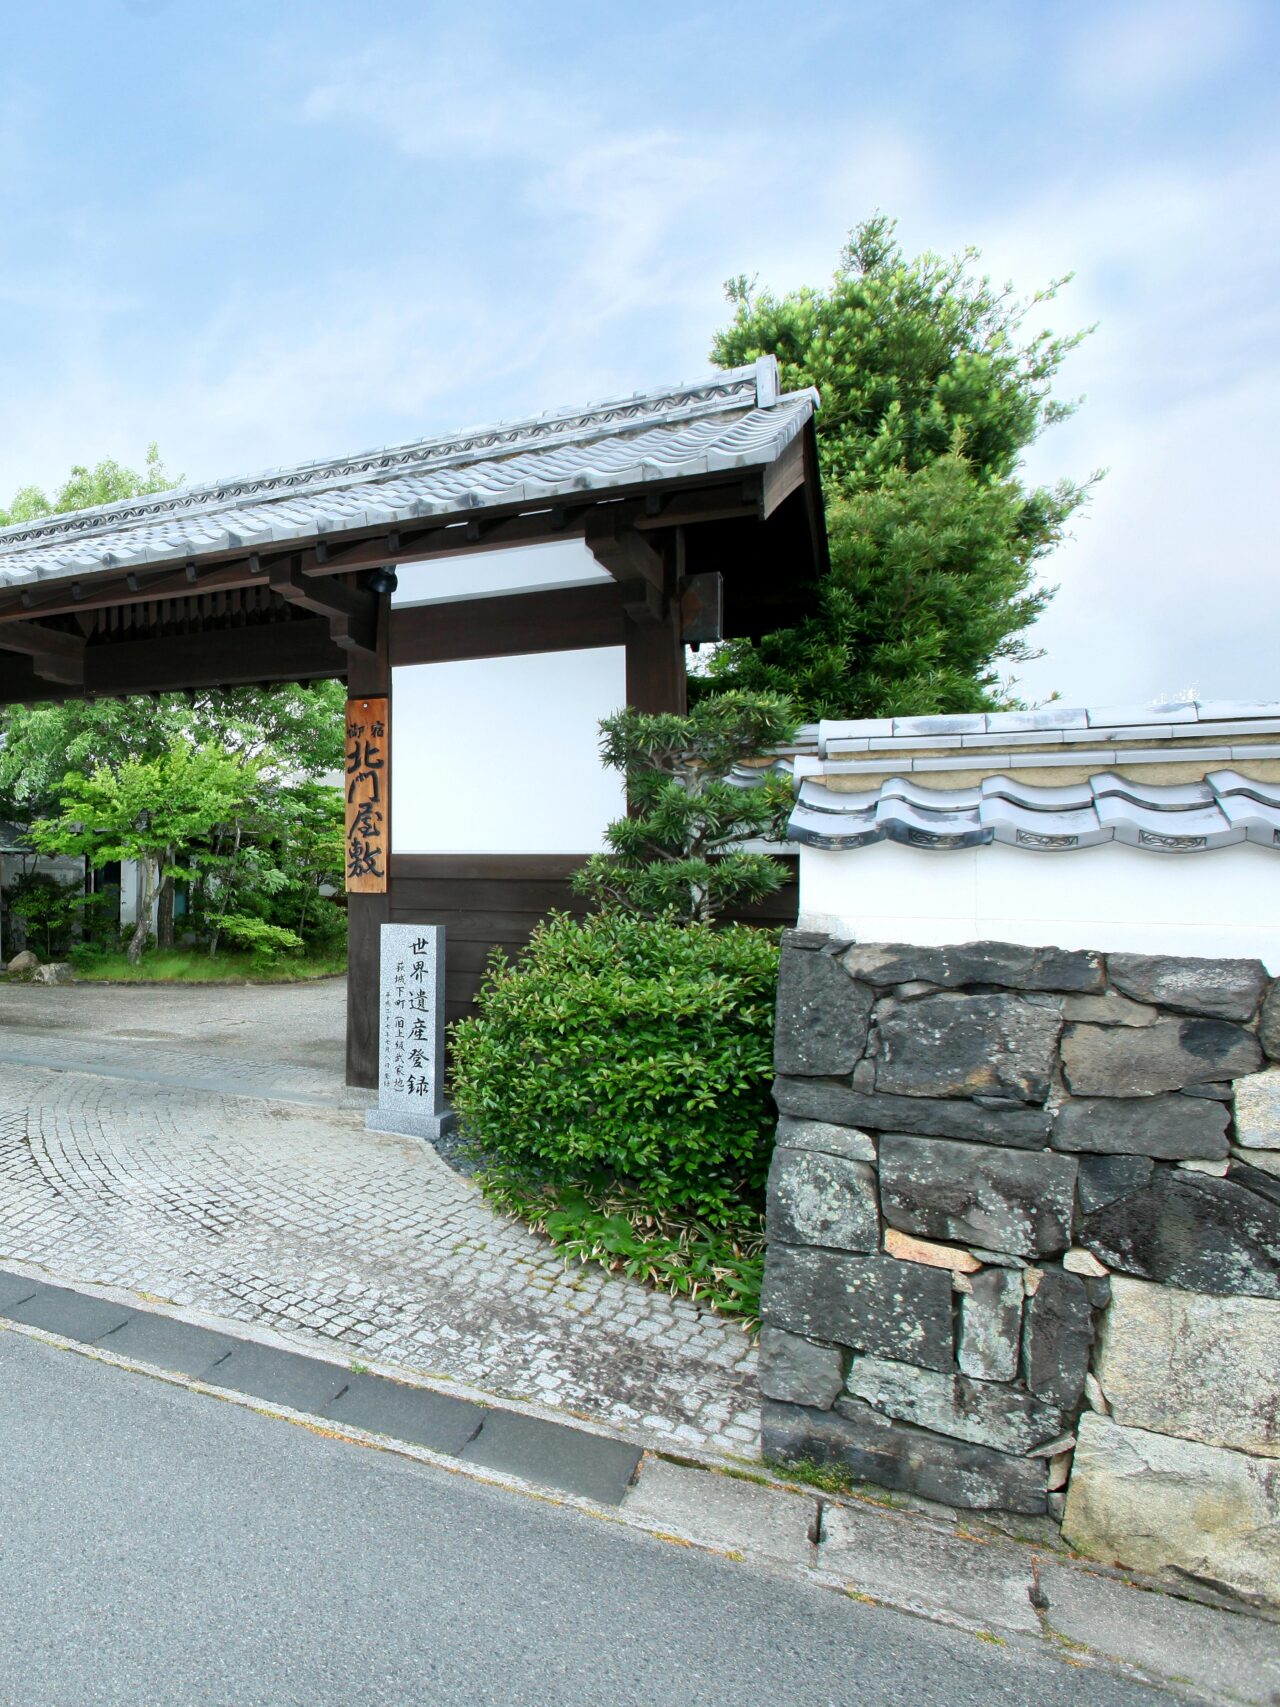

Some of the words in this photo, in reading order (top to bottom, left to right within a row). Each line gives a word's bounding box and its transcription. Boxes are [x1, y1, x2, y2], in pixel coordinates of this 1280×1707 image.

[347, 740, 384, 878] 北門屋敷
[407, 937, 429, 1097] 世界遺産登録
